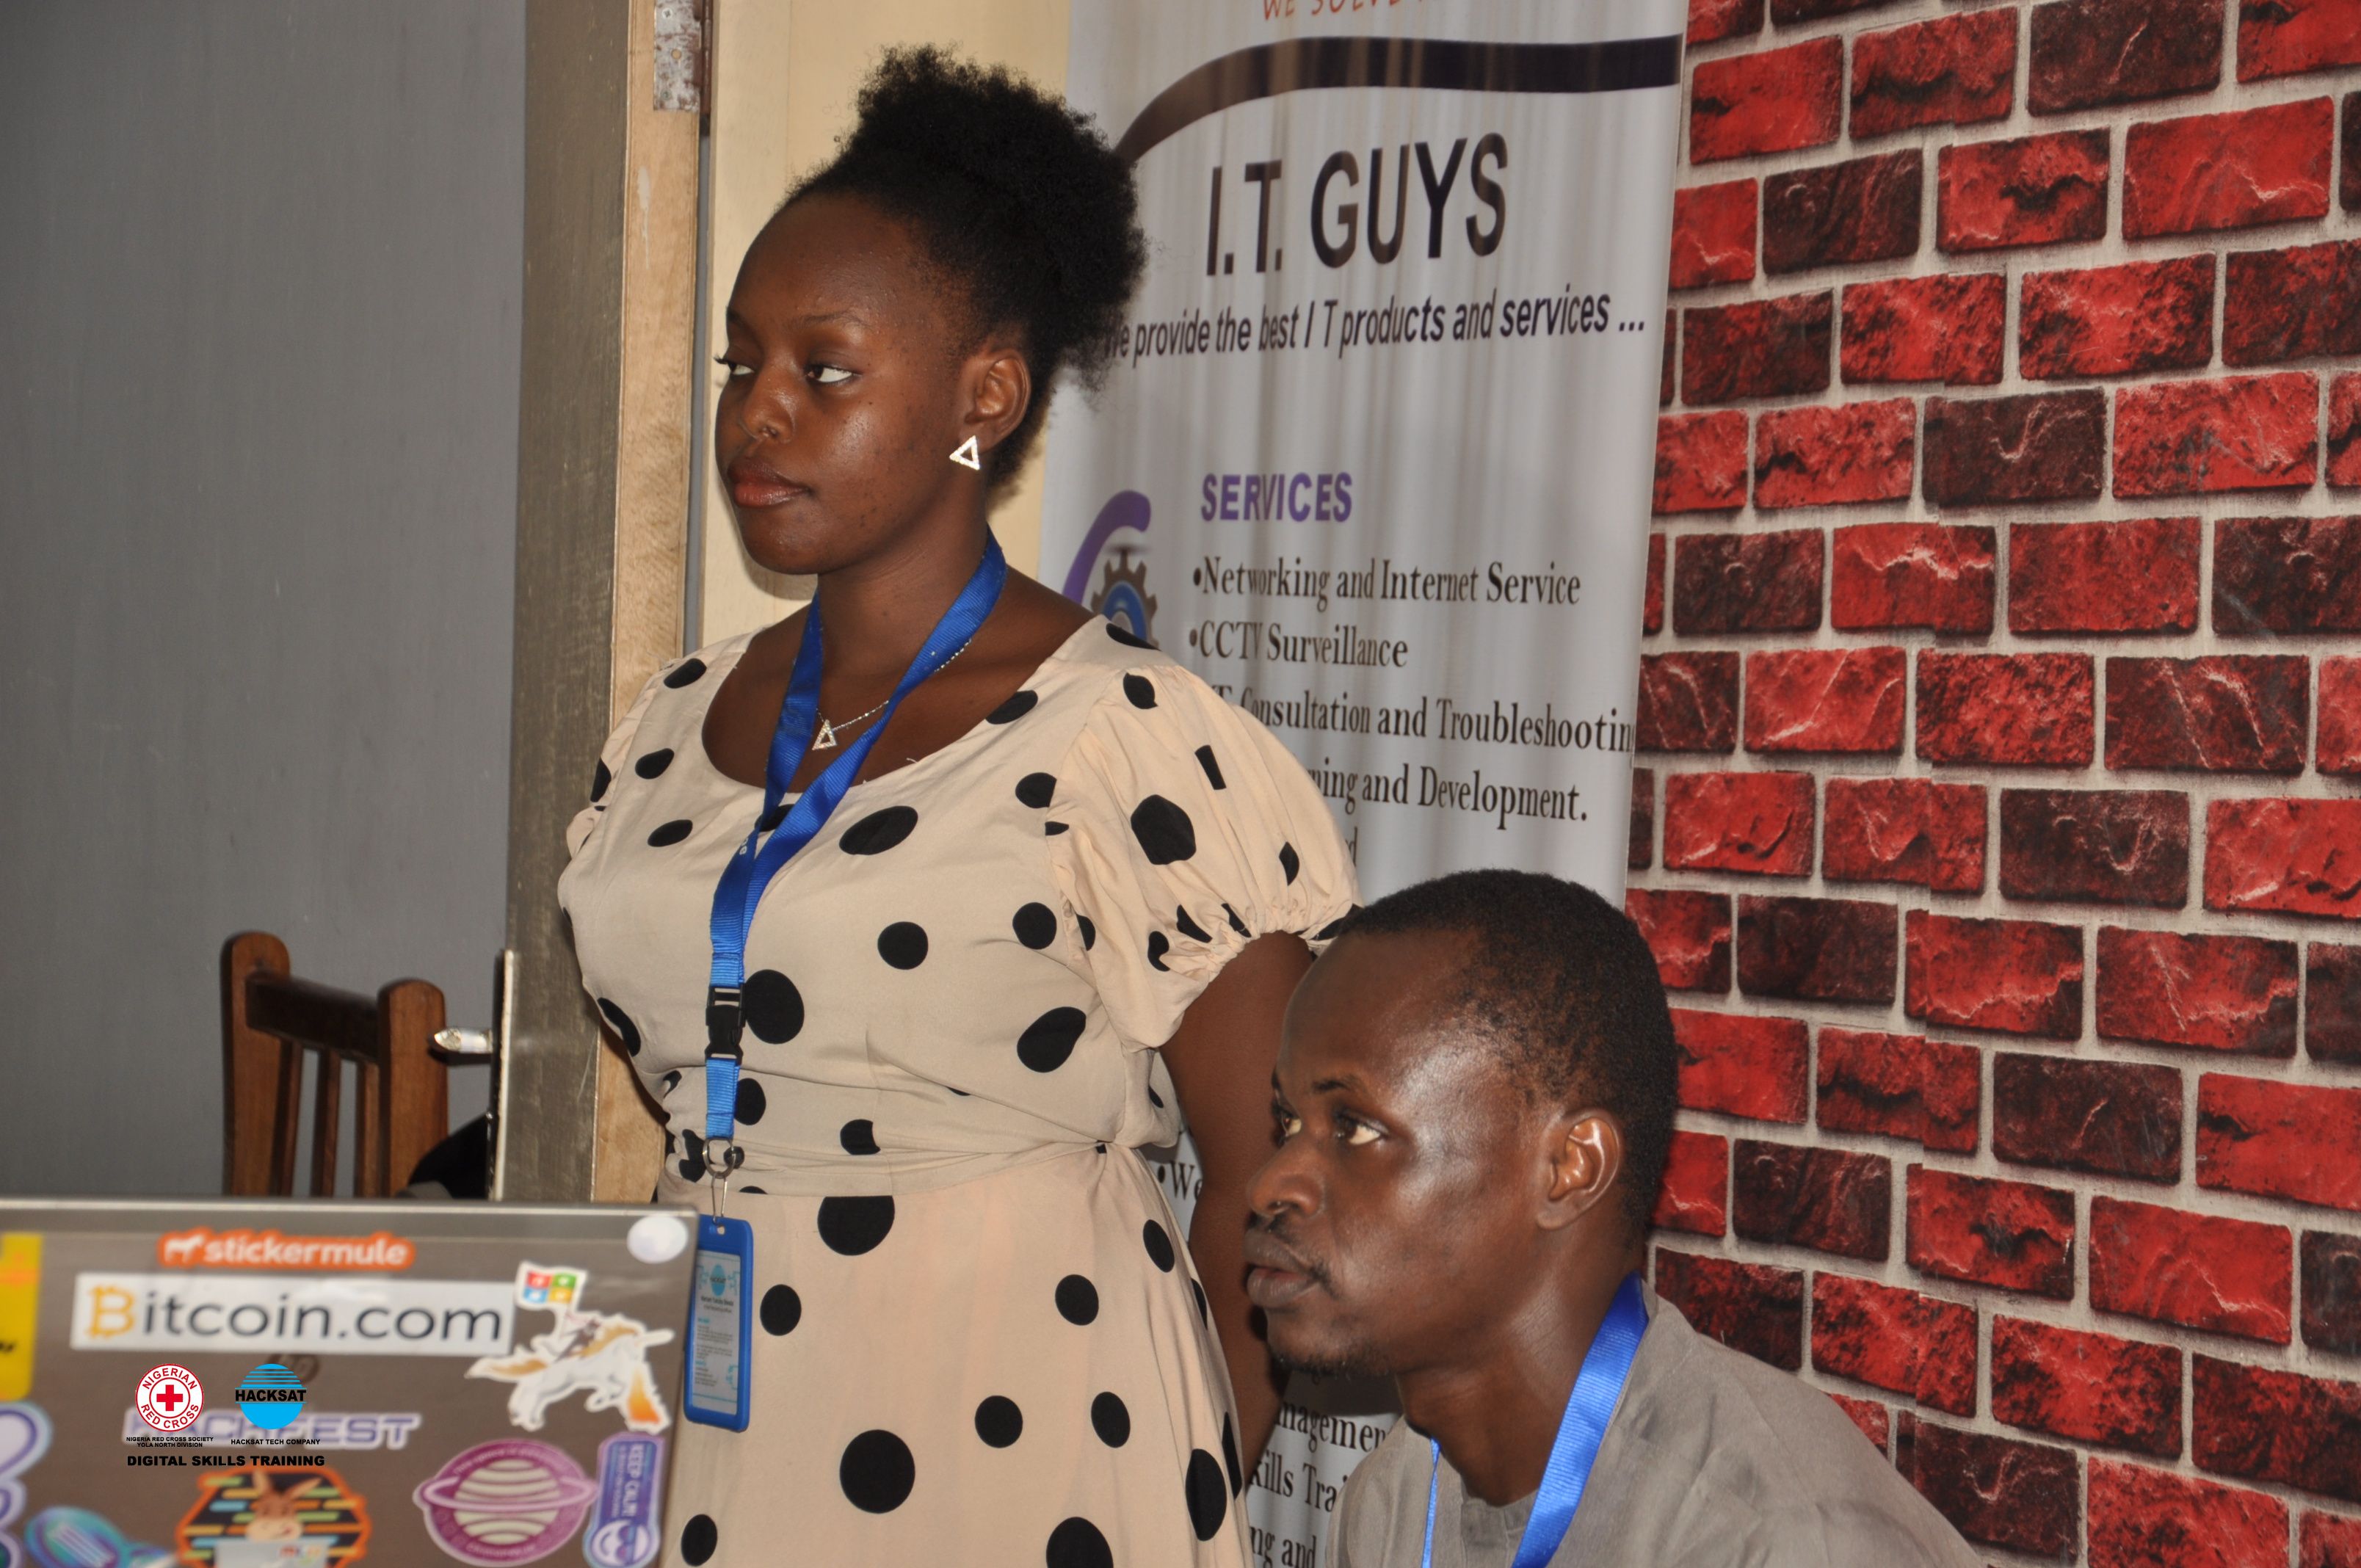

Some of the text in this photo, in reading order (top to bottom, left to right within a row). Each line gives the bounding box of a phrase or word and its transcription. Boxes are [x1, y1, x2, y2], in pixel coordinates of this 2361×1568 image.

[1206, 132, 1508, 276] I.T. GUYS
[1133, 307, 1211, 369] provide
[1215, 305, 1251, 353] the
[1258, 303, 1300, 352] best
[1338, 294, 1446, 360] products
[1452, 287, 1498, 341] and
[1500, 283, 1611, 338] services
[1200, 471, 1353, 523] SERVICES
[1201, 555, 1581, 612] Networking and Internet Service
[1200, 619, 1409, 667] CCTV Surveillance
[1377, 696, 1428, 738] and
[1436, 697, 1634, 752] Troubleshootin
[1362, 763, 1410, 805] and
[1418, 765, 1588, 830] Development.
[204, 1235, 409, 1266] stickermule
[84, 1285, 501, 1340] Bitcoin.com
[1281, 1535, 1316, 1568] and
